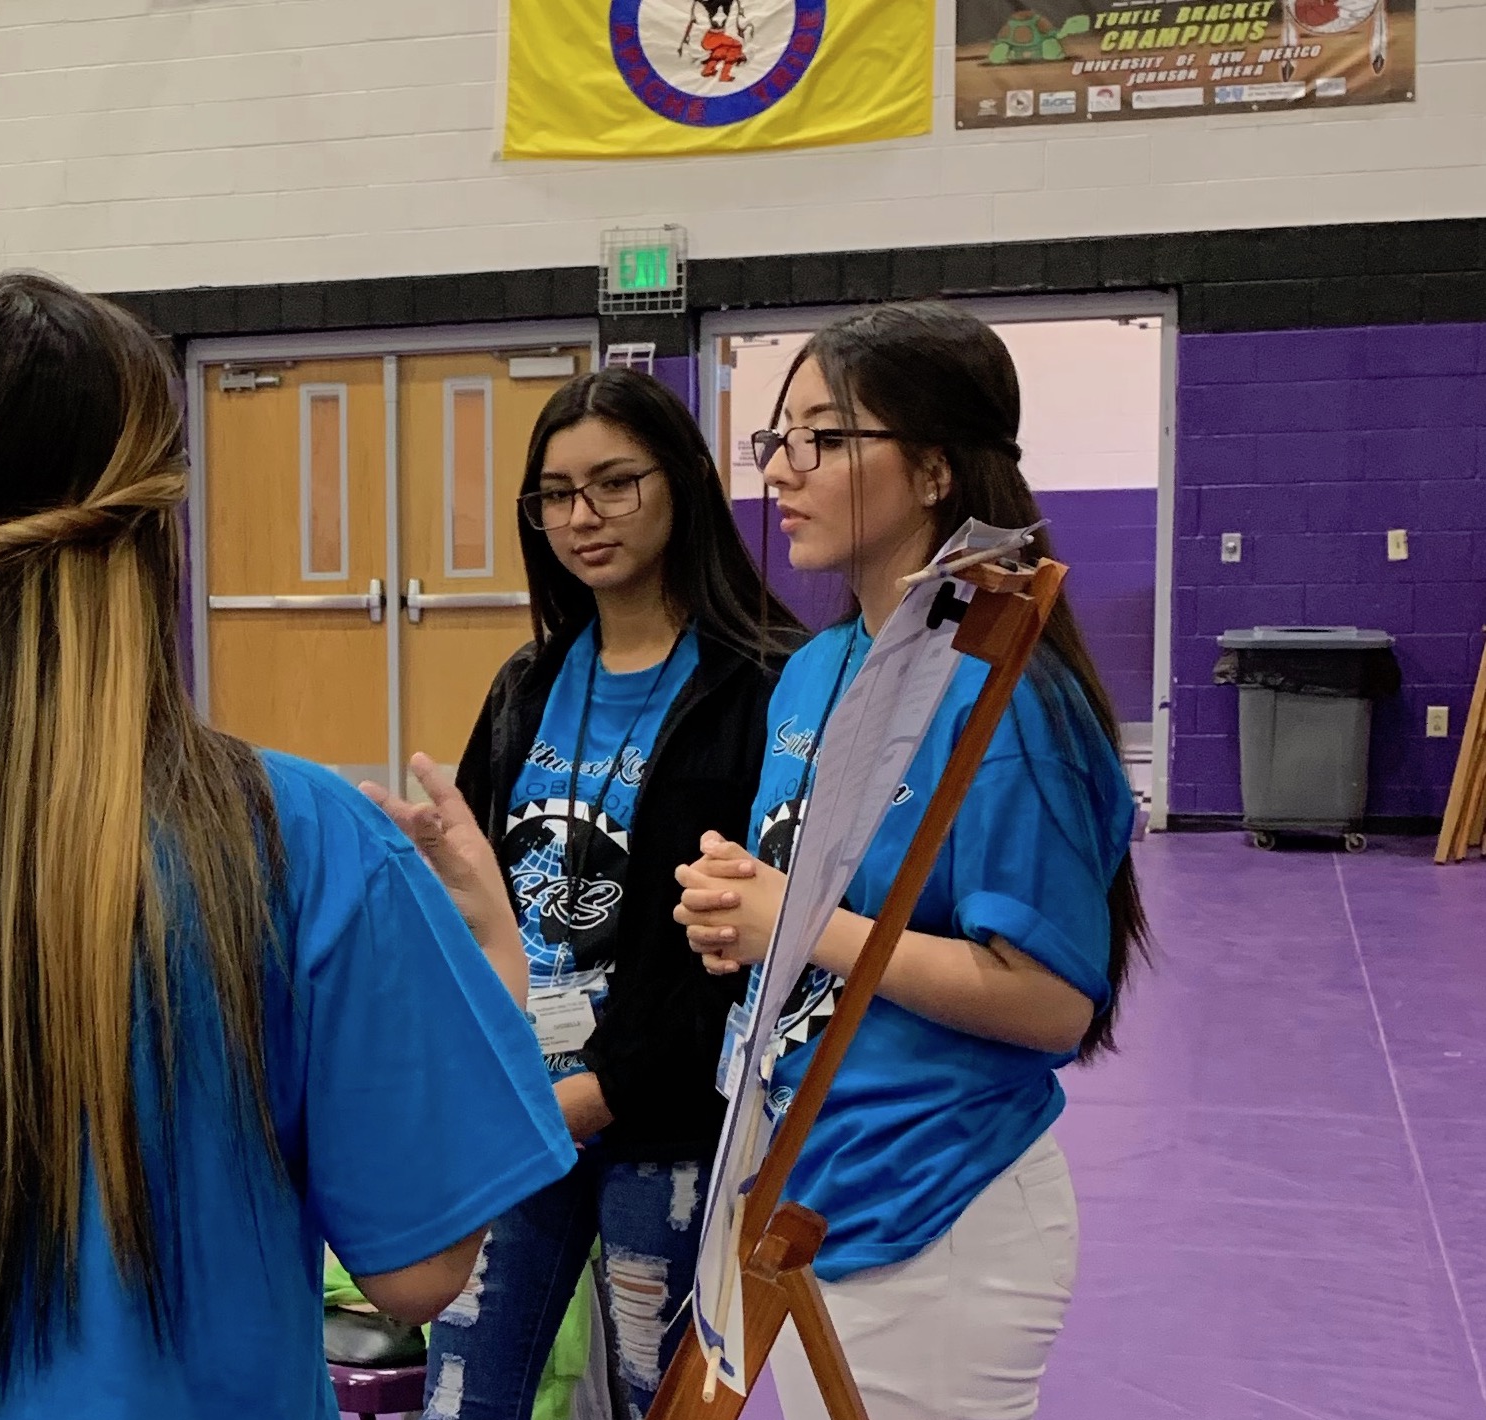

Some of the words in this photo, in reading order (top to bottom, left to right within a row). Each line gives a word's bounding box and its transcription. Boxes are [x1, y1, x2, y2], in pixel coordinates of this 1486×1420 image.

[1094, 8, 1162, 29] TURTLE
[1175, 1, 1274, 24] BRACKET
[1099, 21, 1269, 51] CHAMPIONS
[615, 24, 707, 121] APACHE
[751, 10, 822, 103] TRIBE
[1071, 56, 1165, 76] UNIVERSITY
[1175, 53, 1196, 67] OF
[1208, 50, 1247, 66] NEW
[1257, 44, 1322, 64] MEXICO
[1126, 68, 1198, 87] JOHNSON
[1211, 64, 1264, 81] ARENA
[619, 245, 670, 289] EXIT
